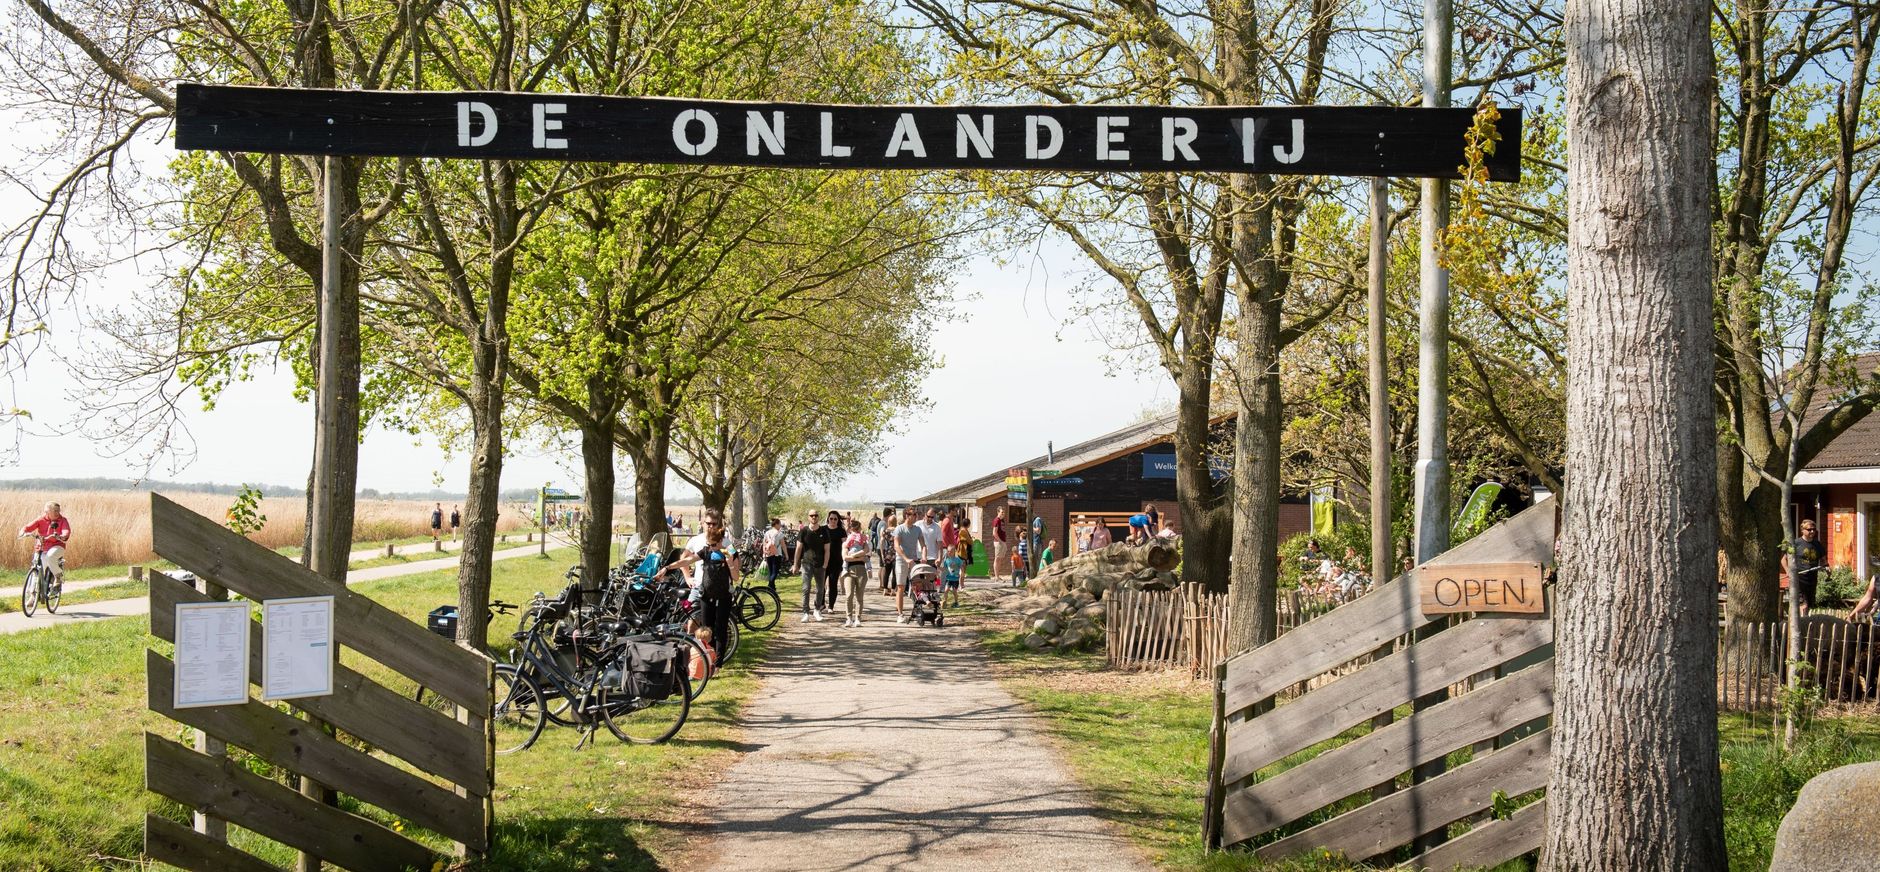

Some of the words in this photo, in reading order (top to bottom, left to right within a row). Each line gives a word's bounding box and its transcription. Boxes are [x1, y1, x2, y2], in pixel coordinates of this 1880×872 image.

[457, 102, 568, 149] DE
[672, 108, 1305, 164] ONLANDERIJ
[1154, 462, 1178, 470] Welko
